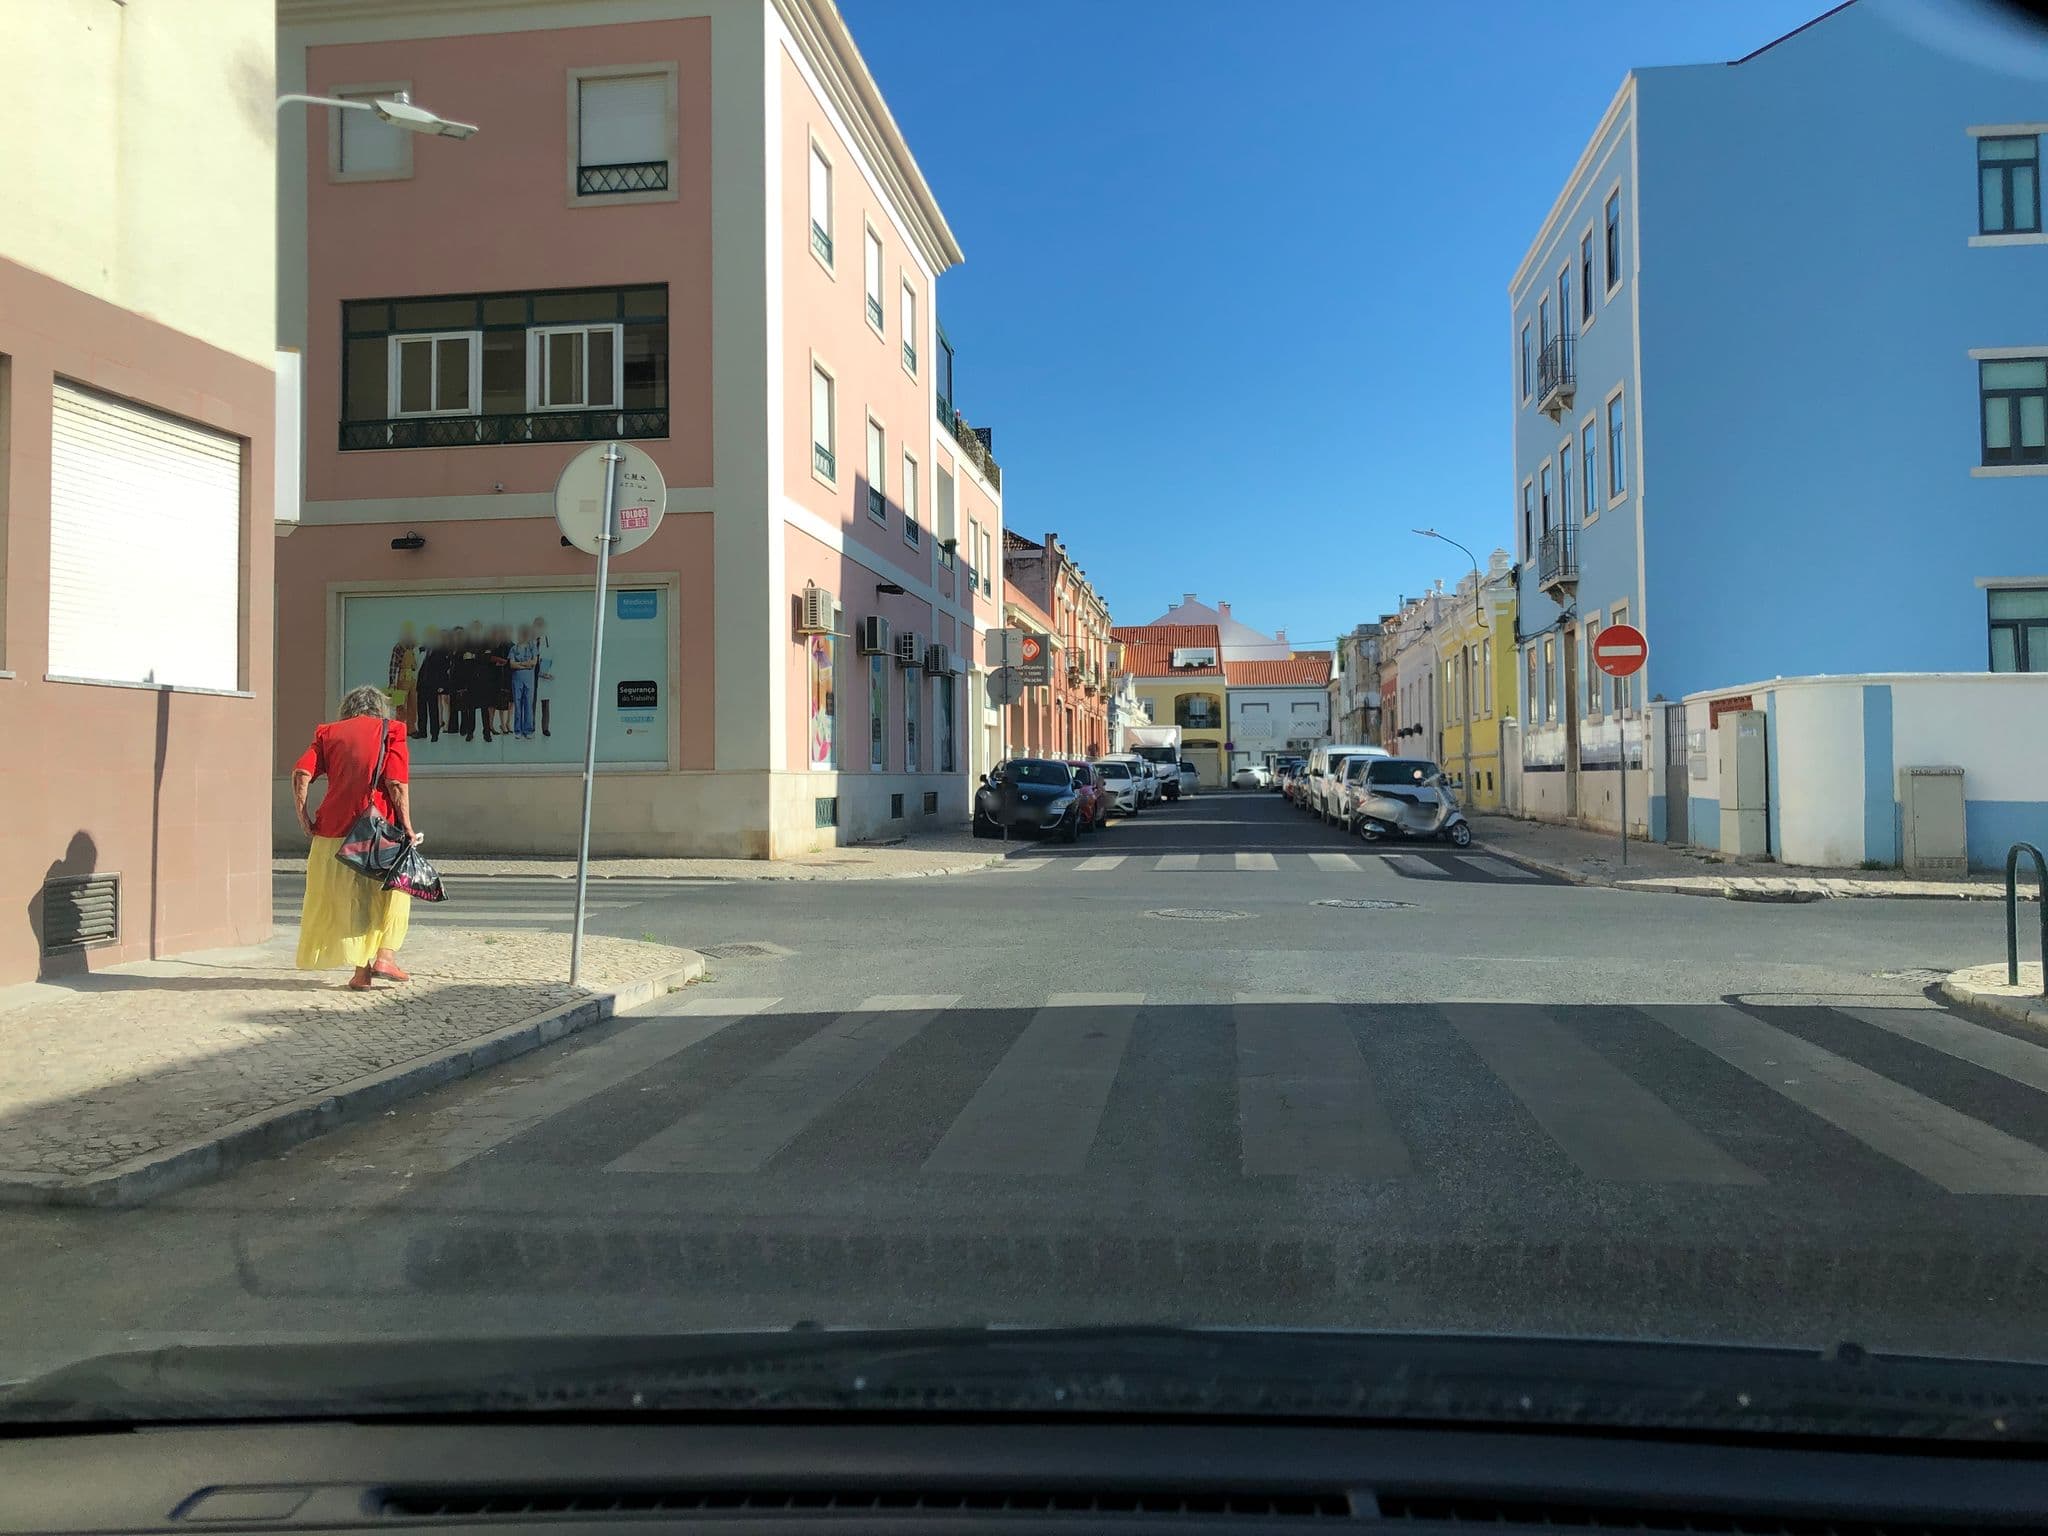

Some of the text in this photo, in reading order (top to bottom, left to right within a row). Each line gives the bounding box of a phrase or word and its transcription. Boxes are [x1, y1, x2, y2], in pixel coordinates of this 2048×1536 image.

[621, 508, 648, 519] TOLDOS
[619, 686, 656, 695] Segurança
[631, 694, 655, 702] Trabalho
